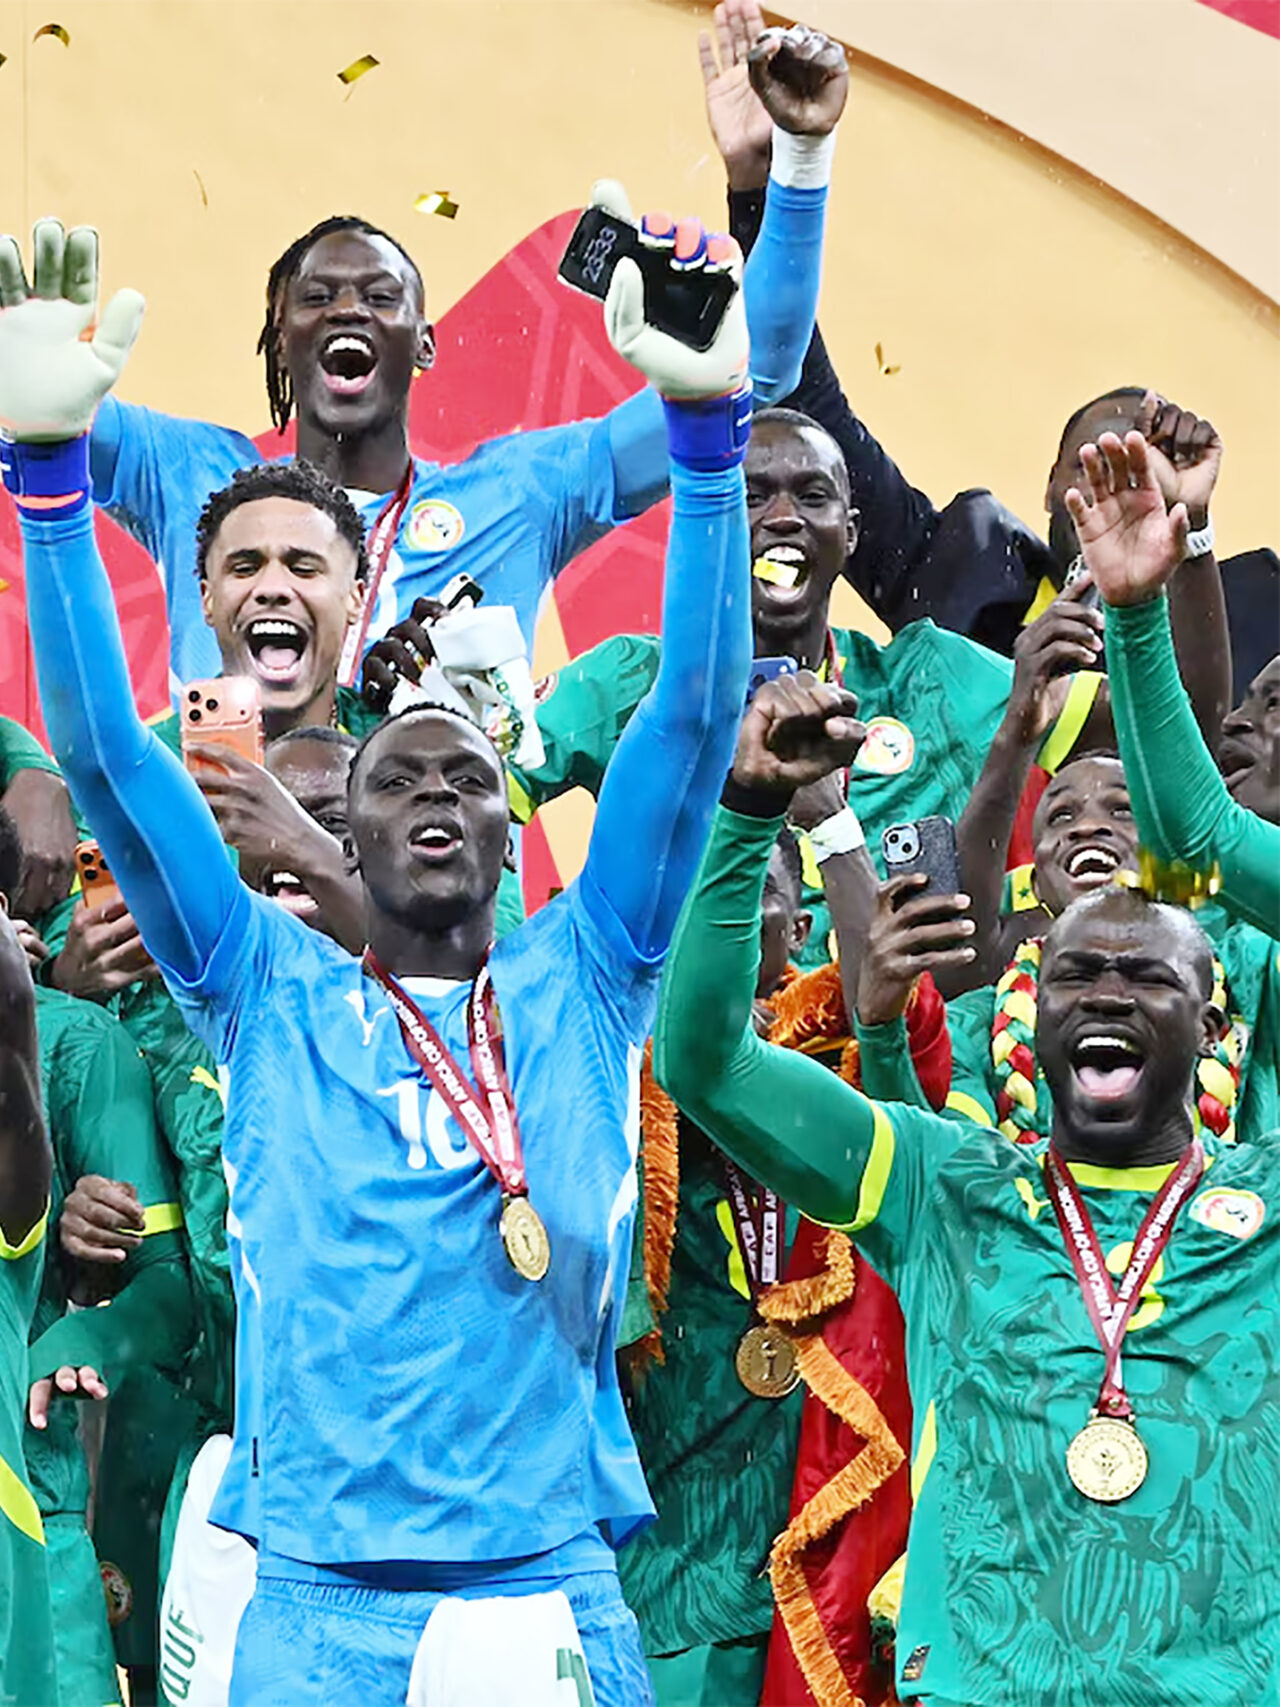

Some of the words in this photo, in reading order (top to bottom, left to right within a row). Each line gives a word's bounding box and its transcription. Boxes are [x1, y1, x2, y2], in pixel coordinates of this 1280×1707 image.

[410, 1026, 428, 1042] OF
[473, 1019, 488, 1044] CUP
[419, 1041, 442, 1064] CUP
[1072, 1232, 1091, 1250] OF
[1079, 1249, 1099, 1274] CUP
[1117, 1261, 1146, 1300] AFRICA
[1135, 1237, 1155, 1262] CUP
[1146, 1222, 1163, 1239] OF
